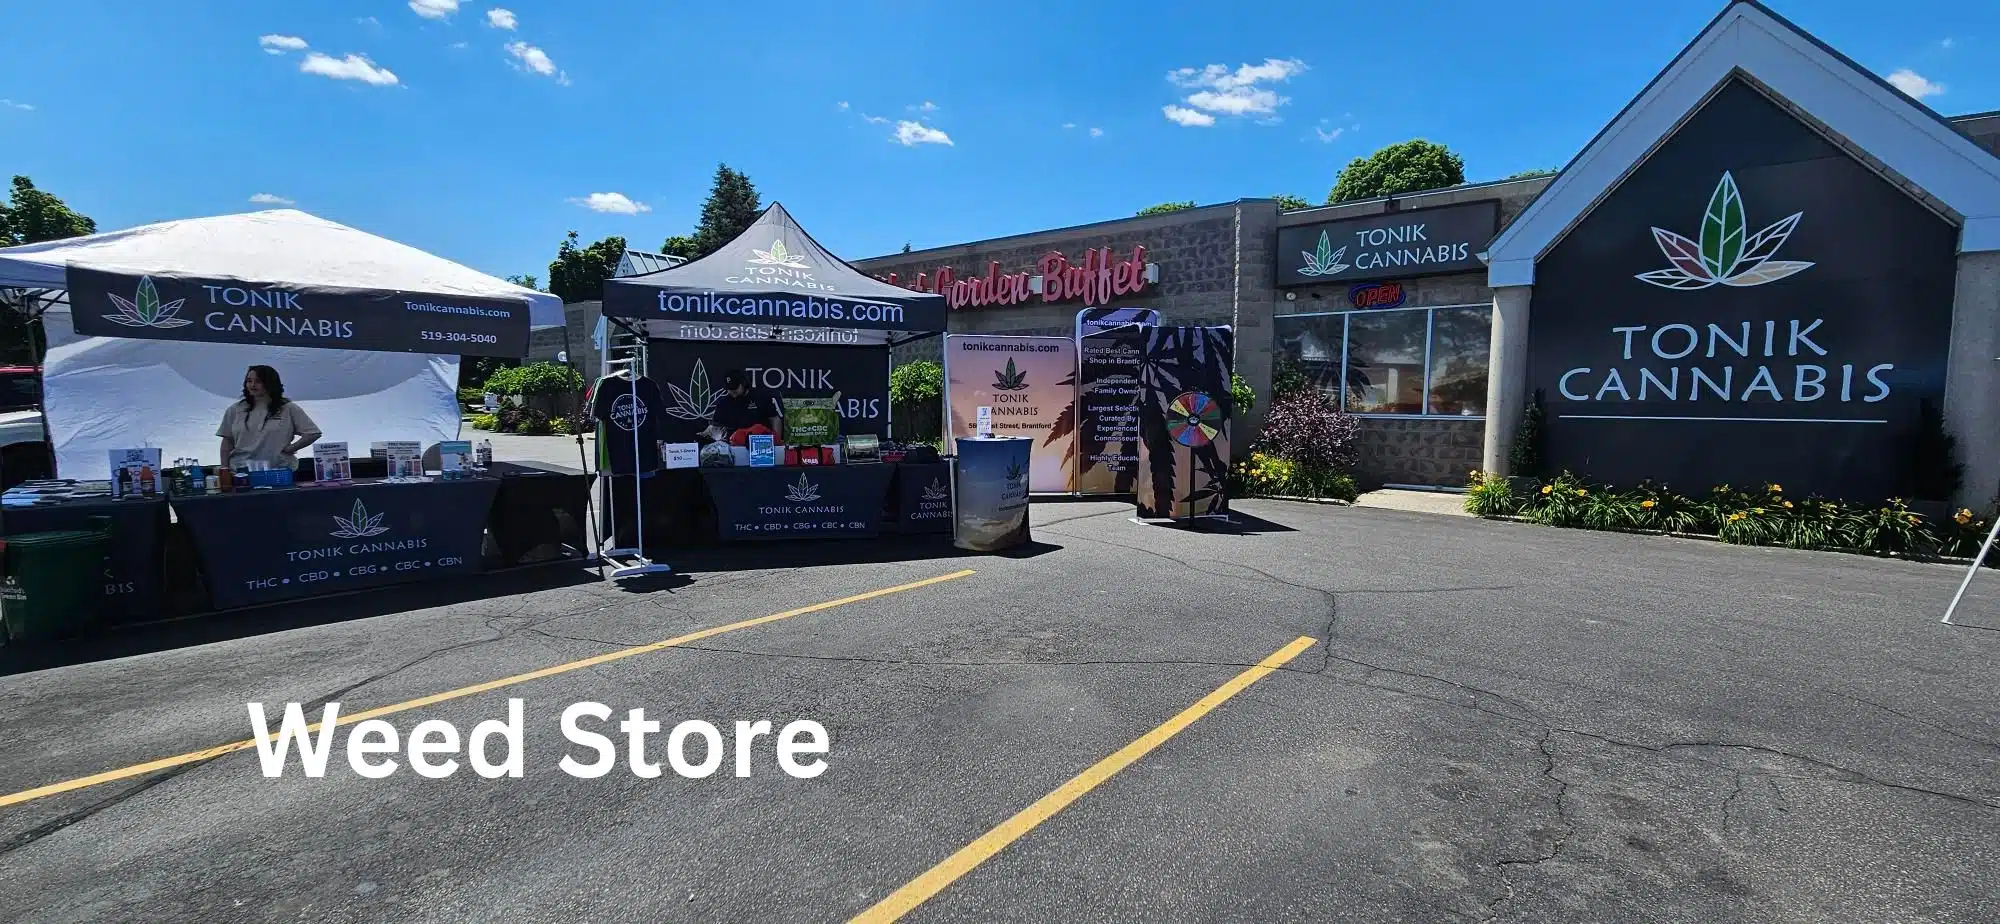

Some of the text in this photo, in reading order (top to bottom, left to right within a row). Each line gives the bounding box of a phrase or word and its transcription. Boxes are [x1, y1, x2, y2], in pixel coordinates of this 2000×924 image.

[1356, 223, 1427, 247] TONIK
[1355, 242, 1469, 270] CANNABIS
[744, 267, 816, 281] TONIK
[935, 261, 1030, 309] Garden
[1037, 245, 1147, 304] Buffet
[725, 276, 836, 292] CANNABIS
[202, 285, 304, 311] TONIK
[1355, 284, 1401, 306] OPEN
[404, 301, 511, 318] Tonikcannabis.com
[657, 290, 904, 323] tonikcannabis.com
[204, 312, 354, 339] CANNABIS
[421, 330, 498, 345] 519-304-5040
[1612, 318, 1829, 361] TONIK
[963, 342, 1060, 353] tonikcannabis.com
[1089, 357, 1107, 365] Shop
[746, 367, 834, 390] TONIK
[1096, 378, 1138, 386] Independent
[1558, 362, 1895, 403] CANNABIS
[992, 393, 1029, 403] TONIK
[1094, 388, 1117, 396] Family
[610, 407, 648, 420] CANNBIS
[991, 407, 1038, 416] ANNABIS
[1090, 455, 1111, 463] Highly
[759, 505, 844, 515] TONIK CANNABIS
[919, 501, 948, 510] TONIK
[764, 523, 782, 531] CBD
[793, 522, 811, 530] CBG
[848, 521, 866, 529] CBN
[286, 538, 428, 562] TONIK CANNABIS
[246, 556, 462, 590] THC CBD CBG CBC CBN
